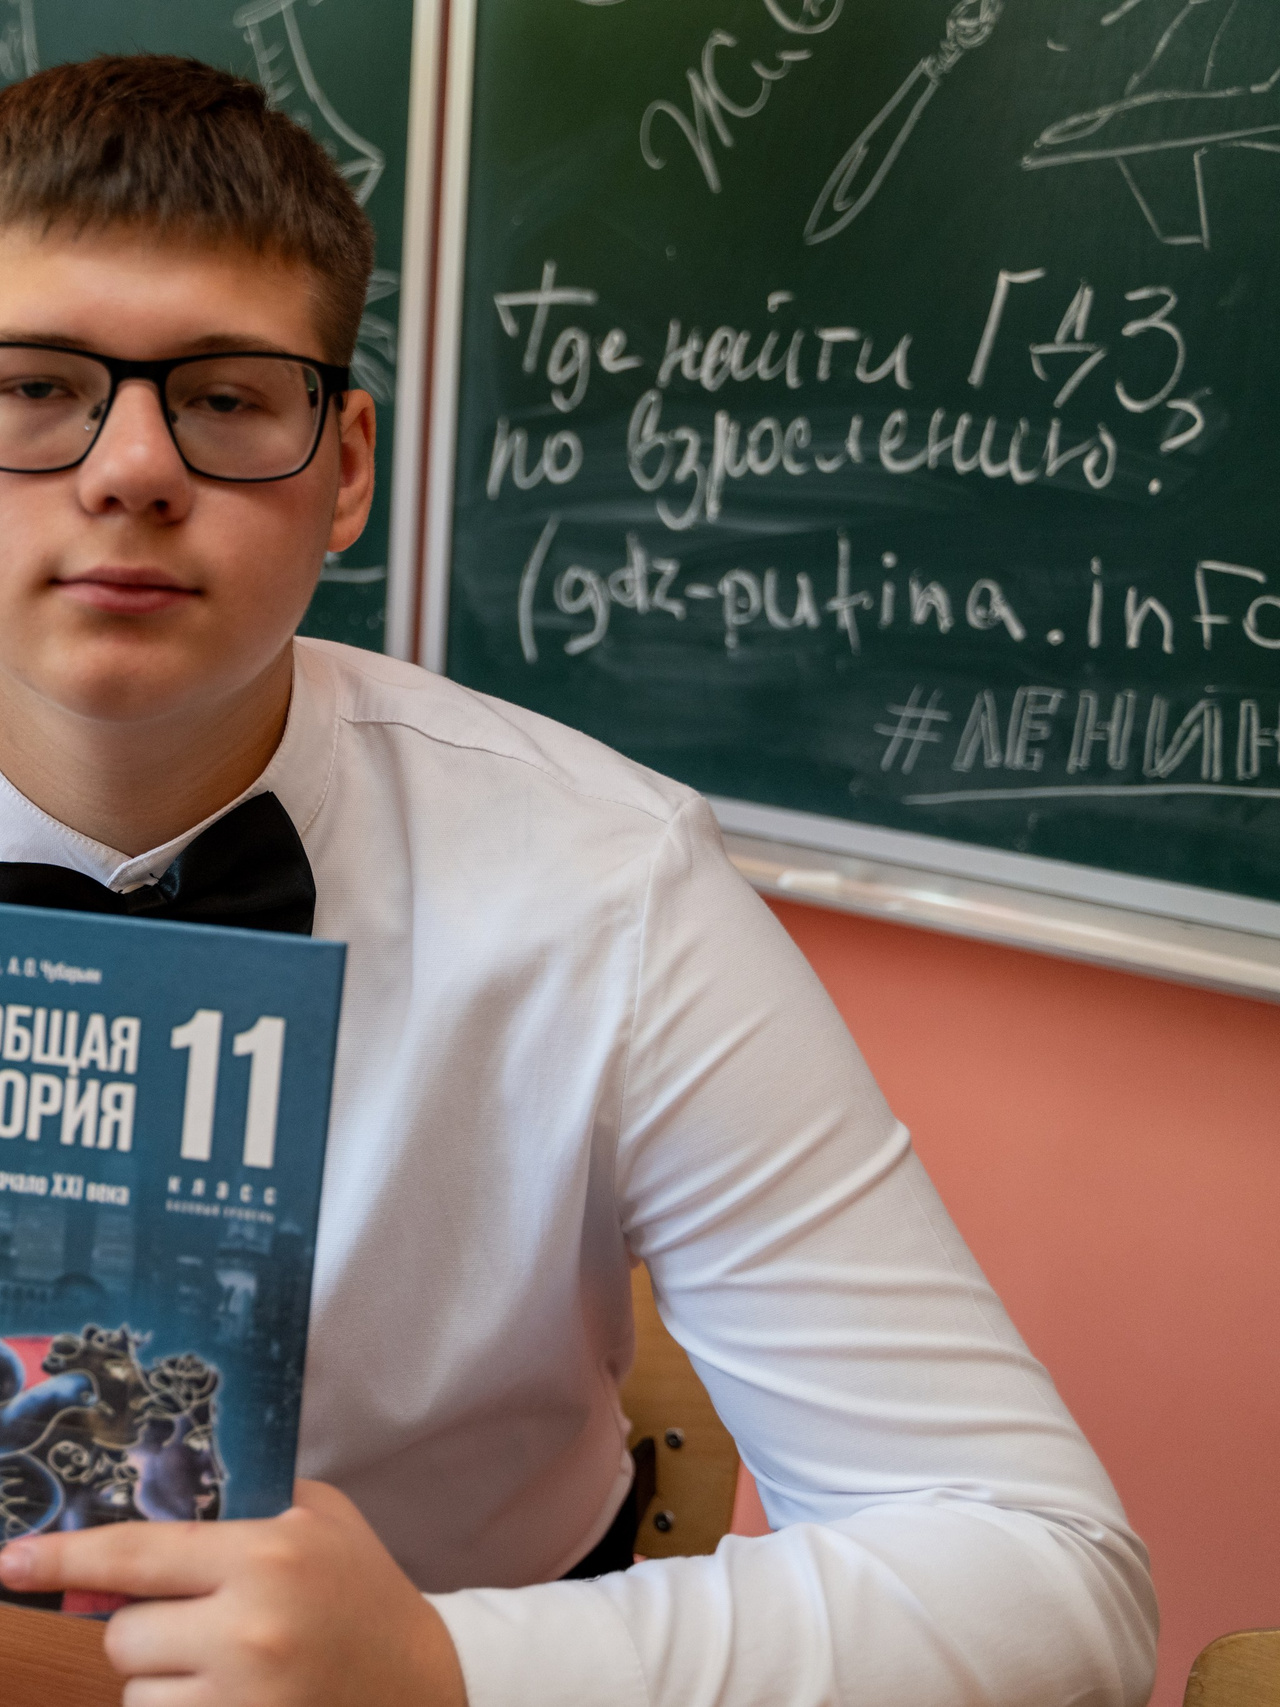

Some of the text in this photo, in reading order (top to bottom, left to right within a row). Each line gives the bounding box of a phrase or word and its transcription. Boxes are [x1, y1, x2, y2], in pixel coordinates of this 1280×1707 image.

[494, 260, 1186, 414] Где найти ГДЗ
[486, 416, 583, 501] по
[170, 1008, 287, 1169] 11
[50, 1172, 85, 1200] XXI
[86, 1181, 131, 1206] века
